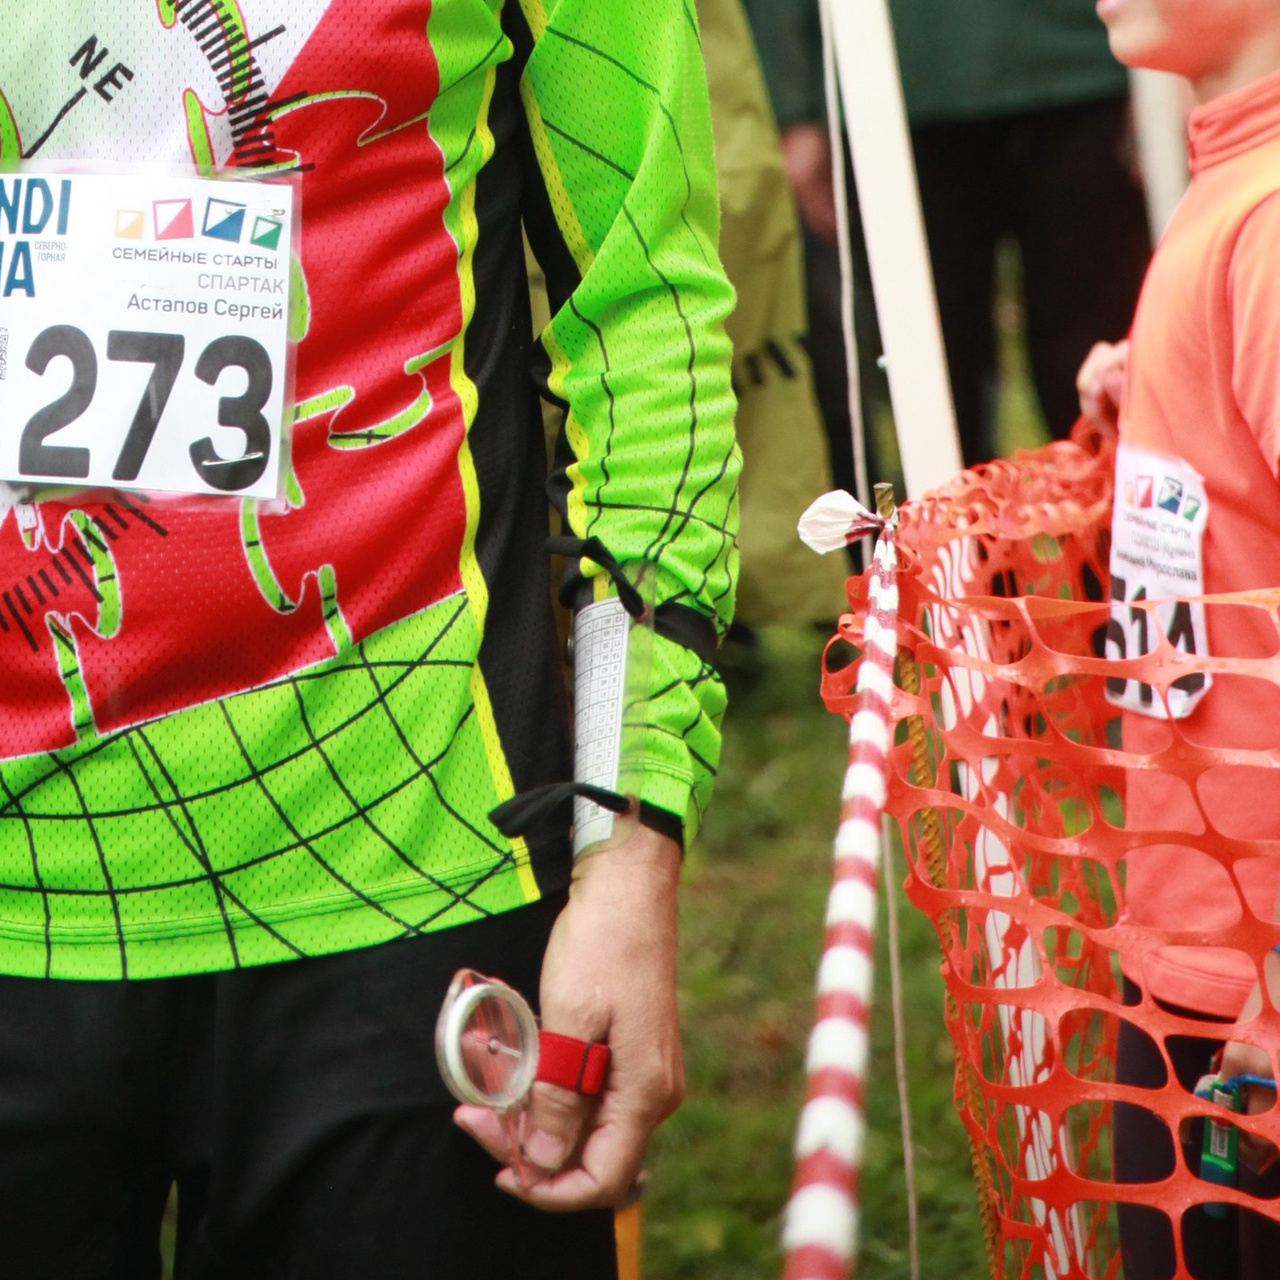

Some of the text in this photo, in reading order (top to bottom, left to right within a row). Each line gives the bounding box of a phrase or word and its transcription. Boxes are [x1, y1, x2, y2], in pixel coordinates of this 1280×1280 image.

[69, 34, 135, 103] NE
[112, 247, 278, 270] СЕМЕЙНЫЕ СТАРТЫ
[197, 273, 285, 295] СПАРТАК
[126, 293, 283, 321] Астапов Сергей
[18, 324, 274, 491] 273
